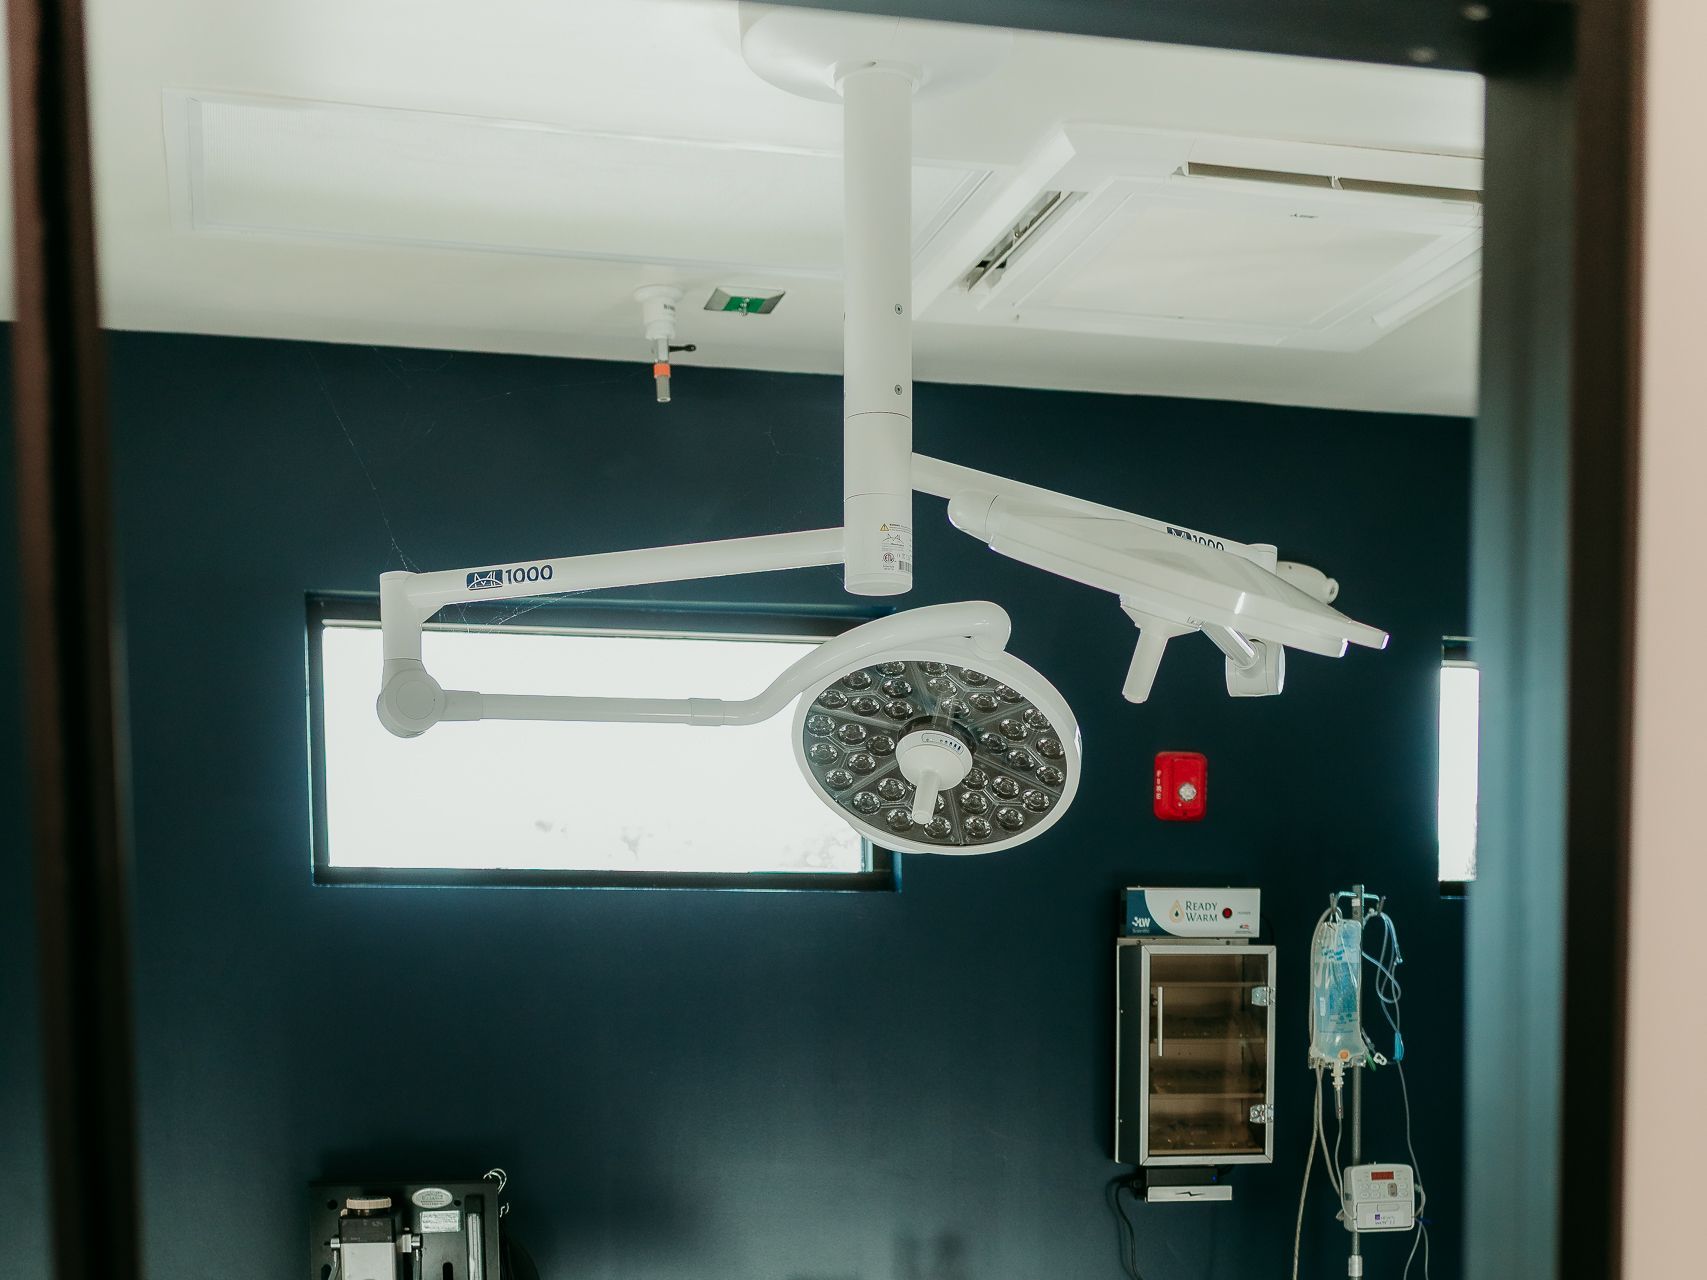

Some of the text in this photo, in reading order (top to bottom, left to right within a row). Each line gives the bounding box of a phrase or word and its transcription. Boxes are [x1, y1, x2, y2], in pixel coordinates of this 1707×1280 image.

[505, 565, 553, 584] 1000
[1185, 900, 1218, 912] READY
[1185, 912, 1218, 923] WARM
